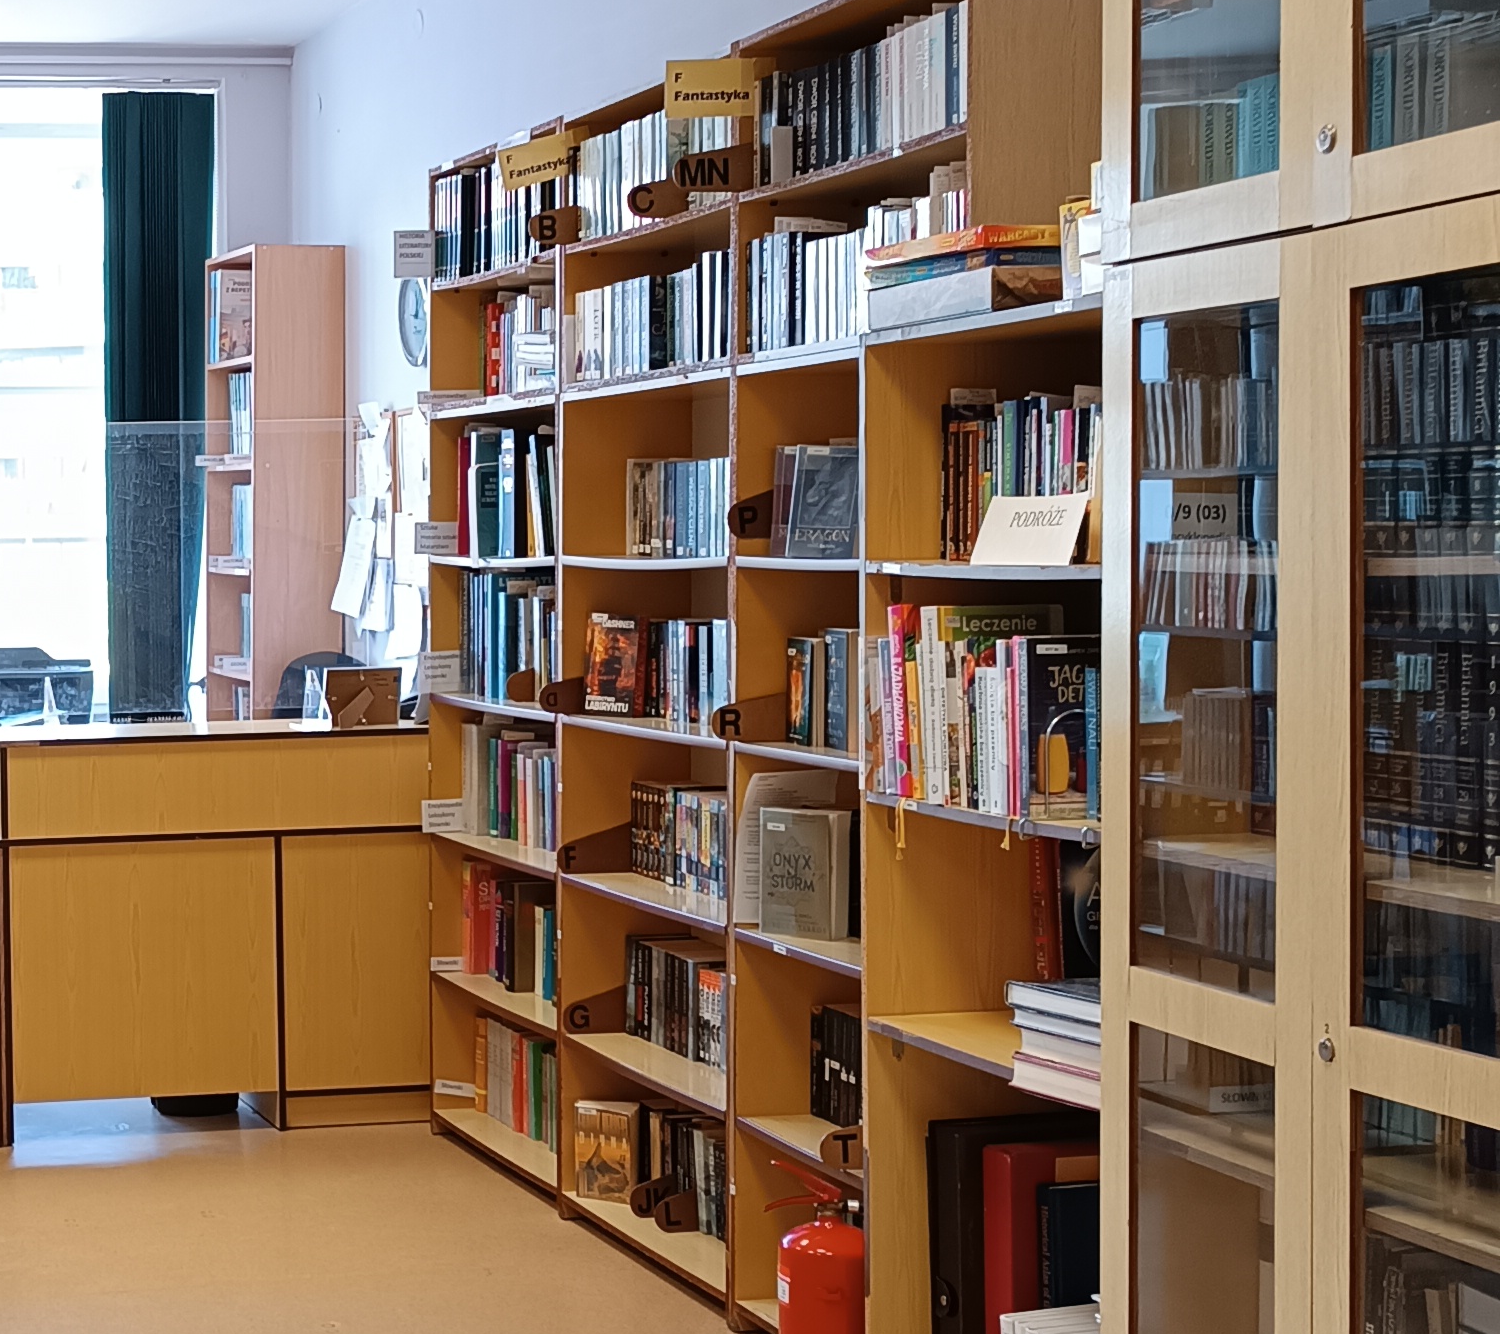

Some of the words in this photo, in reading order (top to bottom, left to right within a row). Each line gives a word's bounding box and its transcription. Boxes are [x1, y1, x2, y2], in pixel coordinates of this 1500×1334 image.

[674, 72, 683, 83] F
[674, 90, 749, 103] Fantastyka
[506, 155, 513, 164] F
[509, 156, 571, 179] Fantastyka
[680, 158, 730, 187] MN
[631, 186, 654, 214] C
[539, 215, 557, 241] B
[738, 505, 758, 534] P
[1009, 504, 1068, 528] PODRÓŻE
[1196, 503, 1227, 524] (03)
[794, 527, 850, 543] ERAGON
[962, 615, 1035, 632] Leczenie
[1461, 652, 1474, 747] Britannica
[719, 708, 741, 736] R
[562, 846, 575, 870] F
[773, 852, 812, 871] ONYX
[771, 874, 816, 893] STORM
[569, 1004, 591, 1029] G
[1324, 1023, 1330, 1034] 2
[832, 1133, 858, 1164] T
[664, 1201, 682, 1226] L
